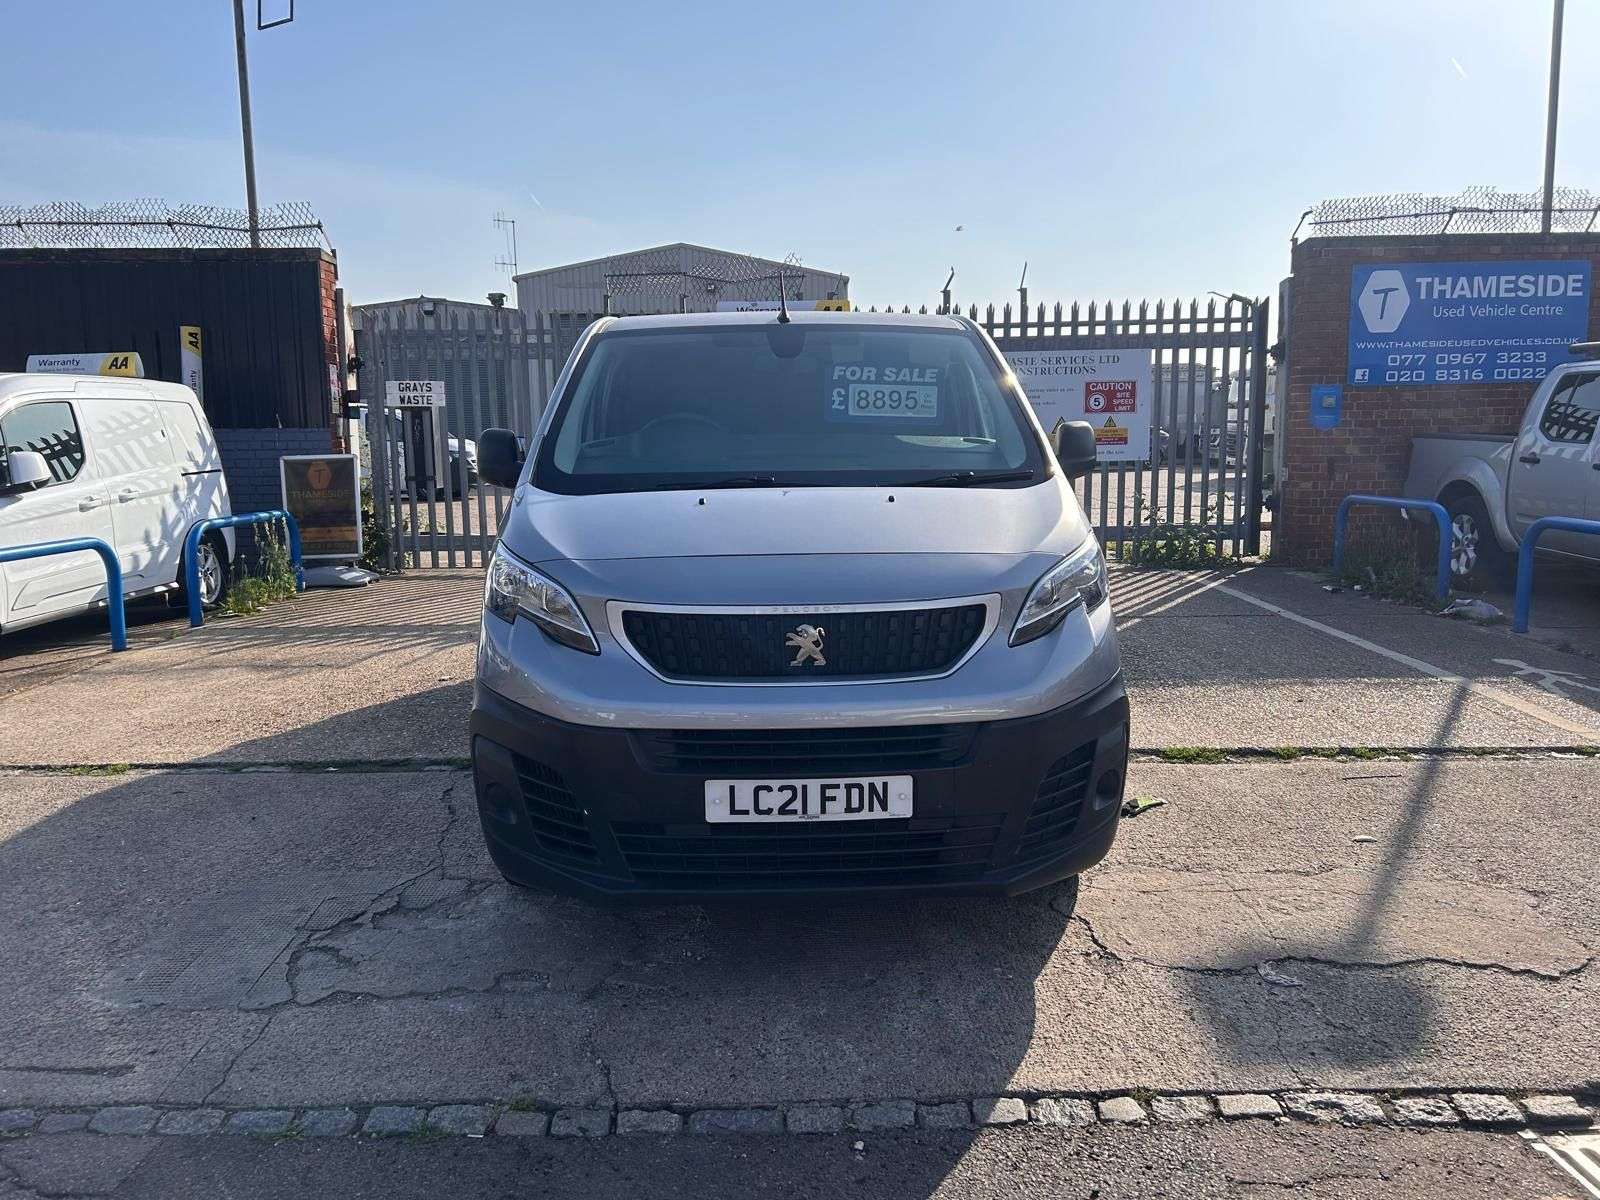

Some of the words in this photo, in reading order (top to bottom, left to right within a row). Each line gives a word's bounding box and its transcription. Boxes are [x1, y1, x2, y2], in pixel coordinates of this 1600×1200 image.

[1416, 275, 1583, 299] THAMESIDE
[1373, 287, 1399, 320] T
[1433, 305, 1464, 317] Used
[1470, 303, 1515, 317] Vehicle
[1520, 303, 1563, 316] Centre
[1356, 337, 1580, 349] WWW.THAMESIDEUSEDVEHICLES.CO.UK
[38, 358, 80, 367] Warranty
[108, 356, 129, 370] AA
[1041, 355, 1095, 365] SERVICES
[1099, 355, 1120, 364] LTD
[1388, 354, 1426, 366] 077
[1435, 353, 1487, 365] 0967
[1497, 352, 1547, 363] 3233
[832, 366, 877, 380] FOR
[883, 367, 938, 382] SALE
[1386, 370, 1425, 382] 020
[1435, 369, 1484, 381] 8316
[1494, 368, 1546, 380] 0022
[398, 382, 433, 392] GRAYS
[1090, 382, 1132, 391] CAUTION
[399, 394, 433, 405] WASTE
[832, 388, 846, 410] £
[856, 389, 918, 410] 8895
[1093, 397, 1101, 407] 5
[729, 784, 808, 816] LC21
[820, 781, 889, 814] FDN
